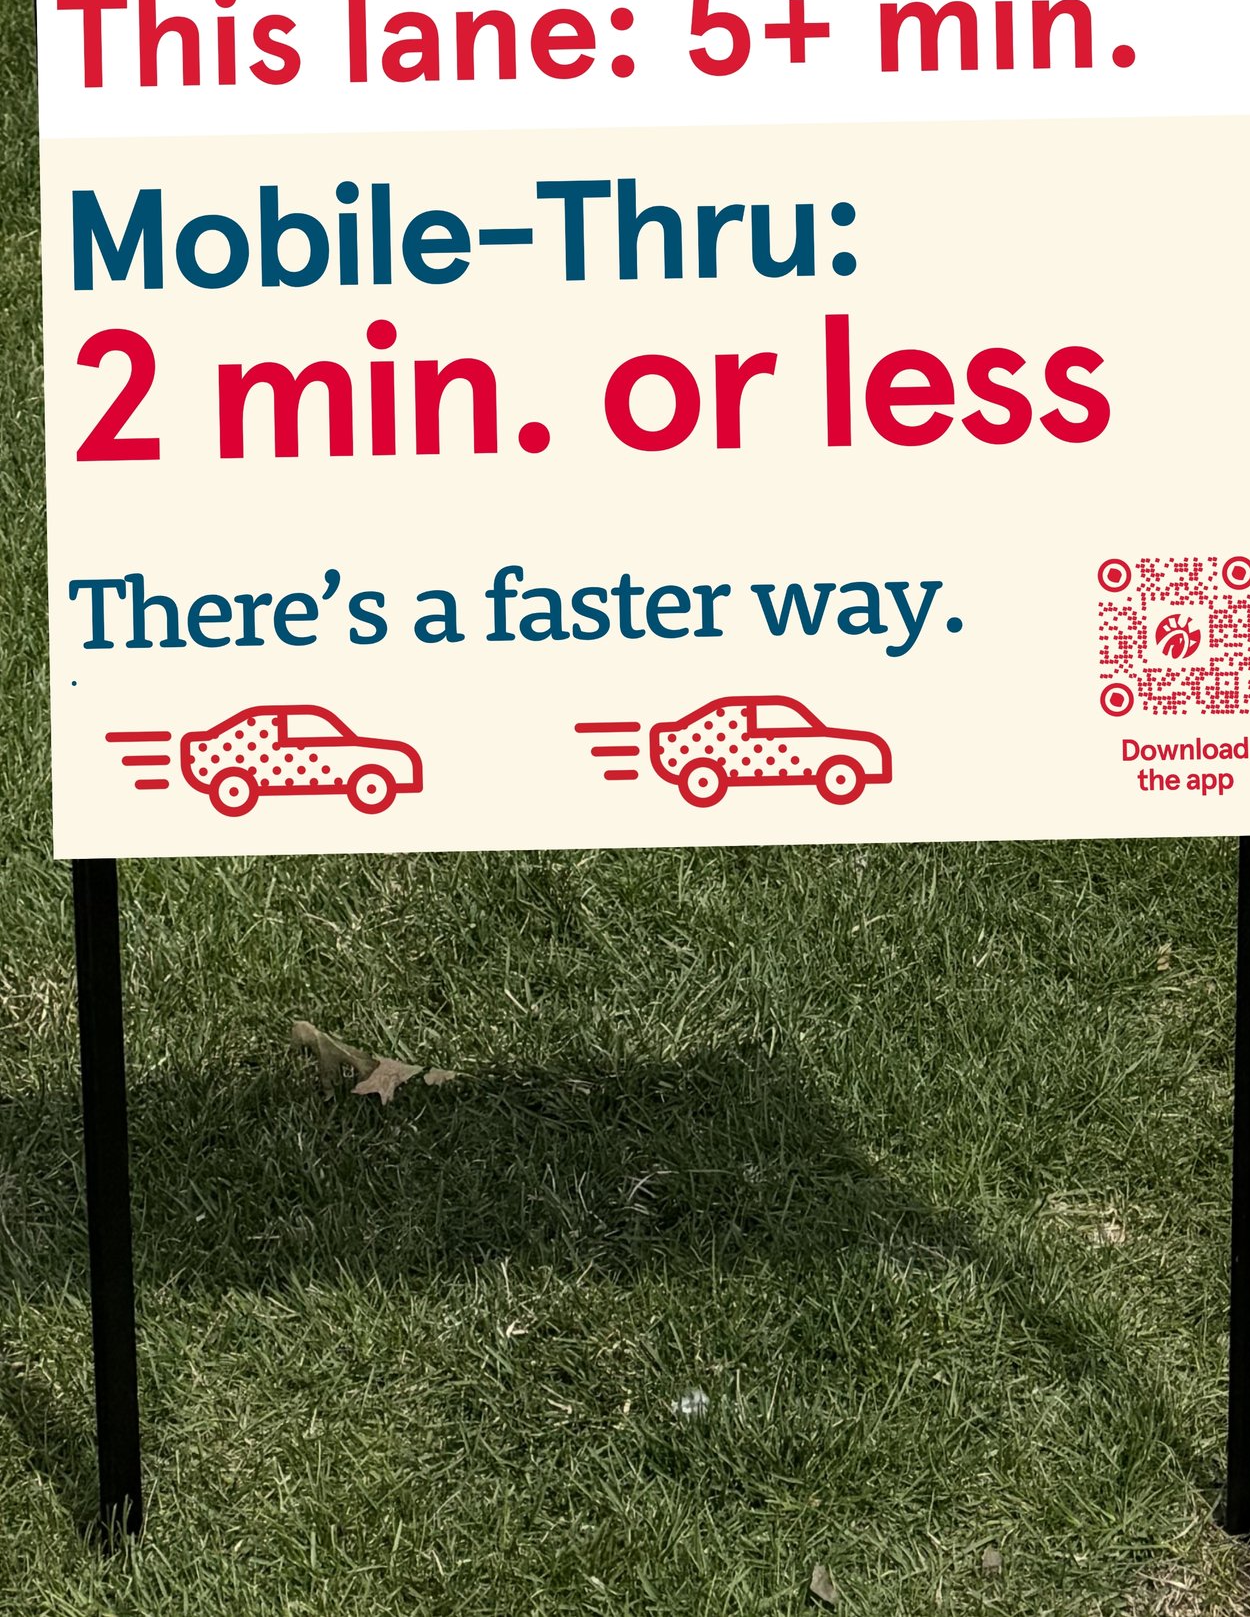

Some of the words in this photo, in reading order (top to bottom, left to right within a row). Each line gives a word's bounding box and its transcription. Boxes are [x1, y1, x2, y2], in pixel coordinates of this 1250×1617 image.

[74, 180, 855, 290] Mobile-Thru:
[76, 329, 160, 462] 2
[218, 319, 550, 459] min.
[604, 352, 778, 452] or
[825, 314, 1110, 446] less
[70, 570, 386, 648] There’s
[416, 591, 463, 642] a
[487, 567, 729, 640] faster
[752, 582, 961, 656] way.
[1122, 737, 1248, 761] Download
[1138, 769, 1180, 790] the
[1187, 773, 1234, 795] app
